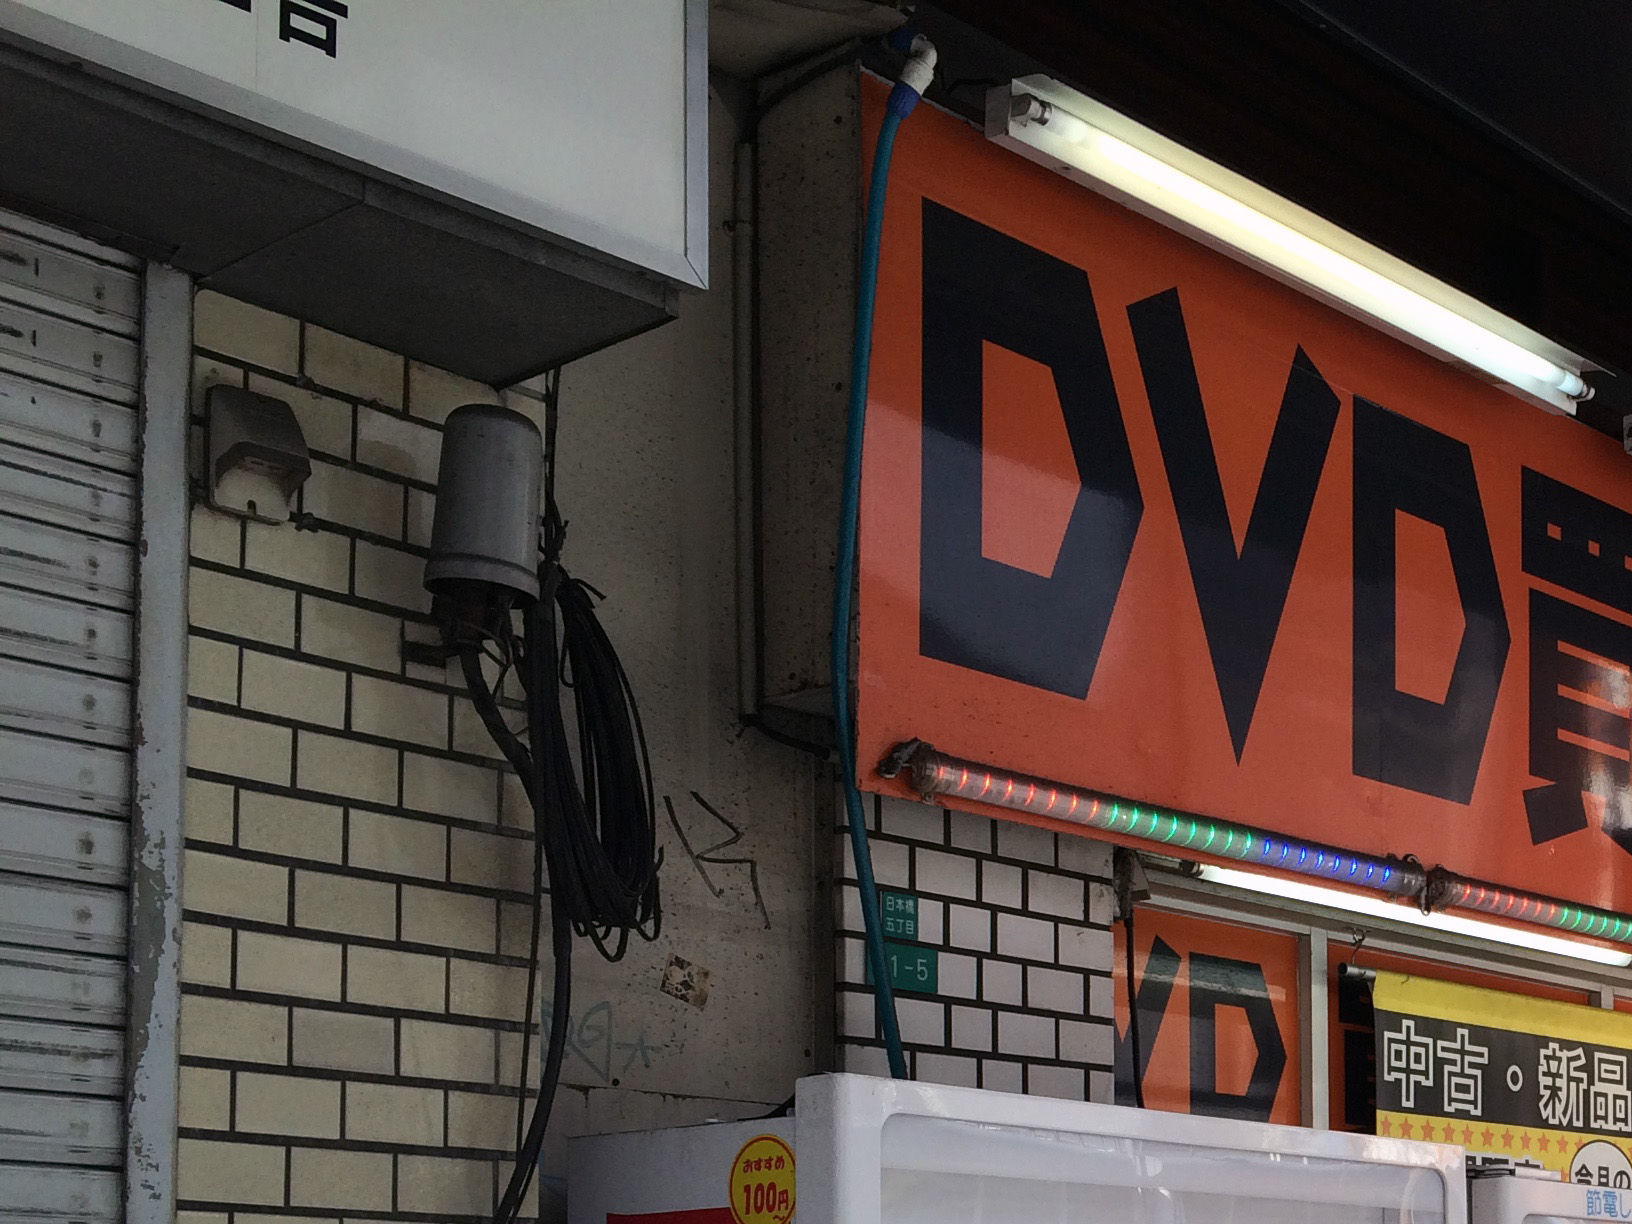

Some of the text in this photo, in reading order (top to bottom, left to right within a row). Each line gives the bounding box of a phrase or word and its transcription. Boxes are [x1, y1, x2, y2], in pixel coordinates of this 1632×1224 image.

[886, 896, 915, 914] 日本橋
[885, 917, 914, 934] 五丁目
[891, 954, 929, 981] 1-5
[743, 1156, 785, 1172] おすすめ
